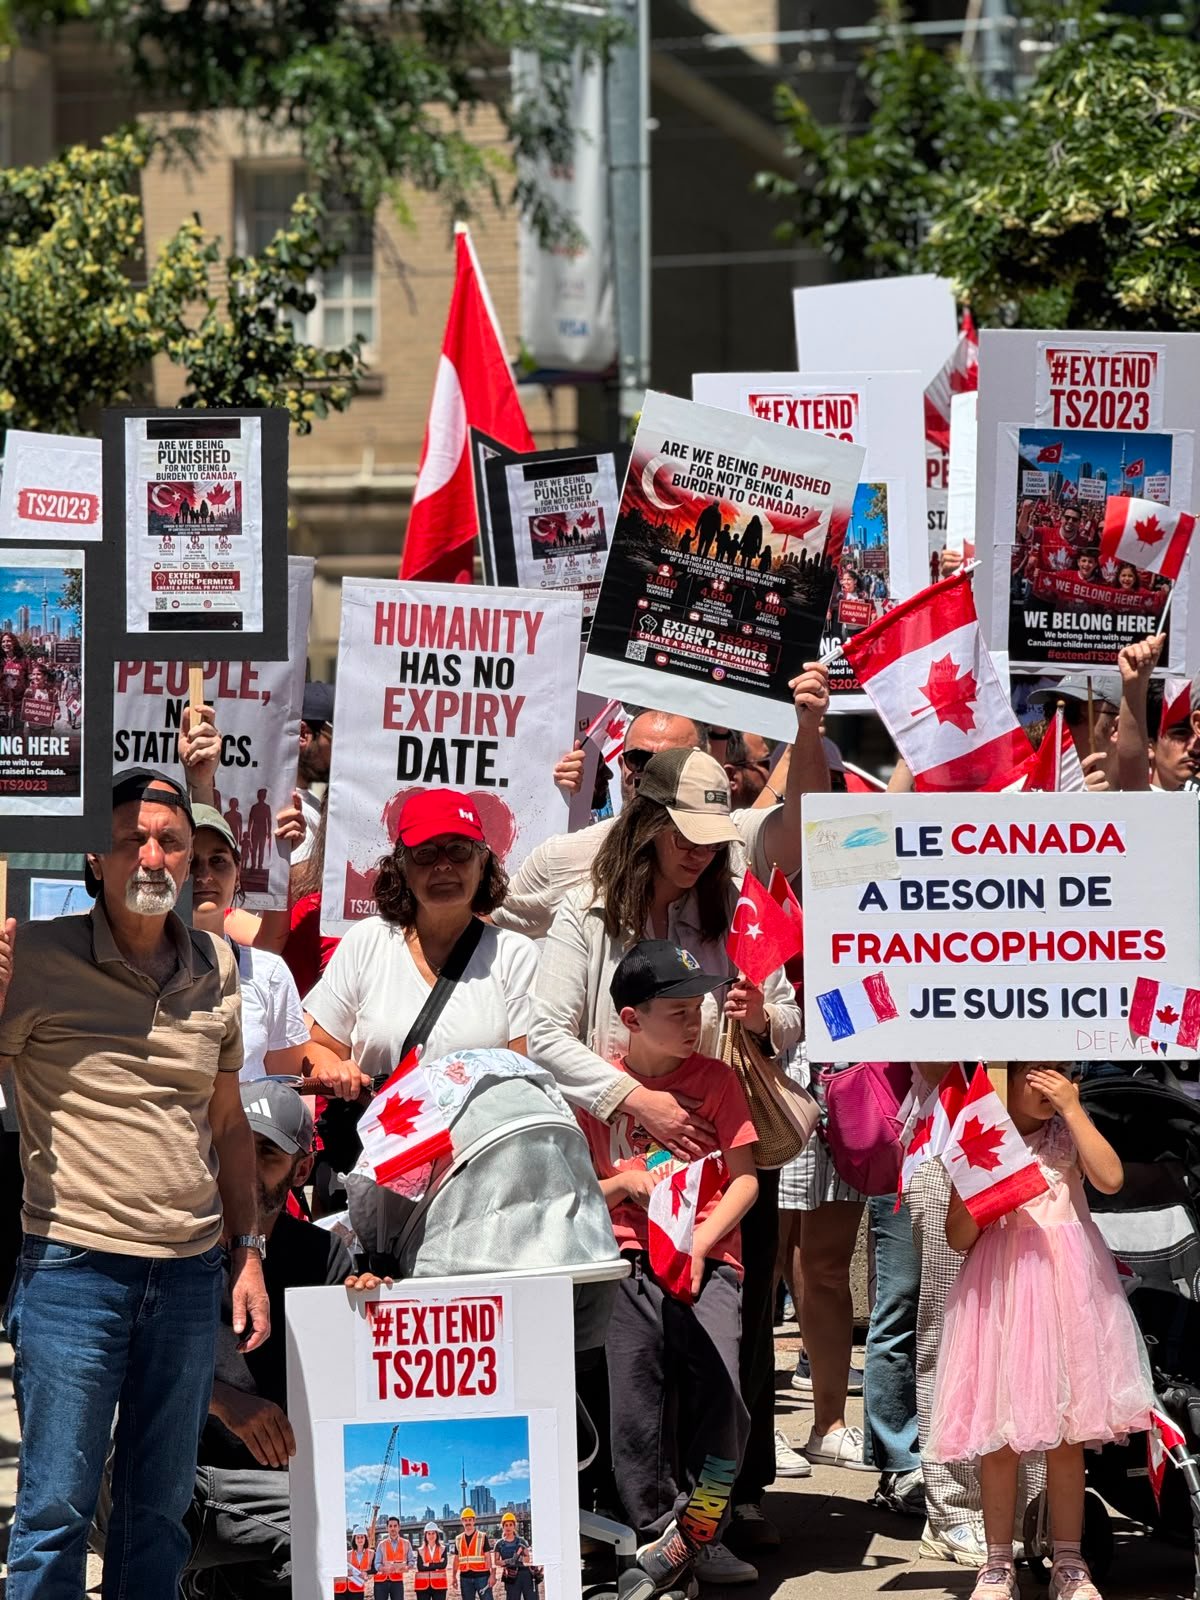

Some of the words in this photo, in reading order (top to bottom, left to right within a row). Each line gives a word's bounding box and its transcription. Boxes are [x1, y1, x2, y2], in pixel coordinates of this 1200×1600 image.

[1051, 356, 1150, 388] #EXTEND
[755, 400, 853, 429] #EXTEND
[1050, 390, 1150, 430] TS2023
[158, 441, 176, 449] ARE
[179, 441, 193, 449] WE
[196, 440, 223, 449] BEING
[158, 450, 231, 464] PUNISHED
[200, 472, 237, 480] CANADA?
[534, 480, 548, 488] ARE
[550, 479, 562, 487] WE
[564, 476, 586, 486] BEING
[660, 440, 689, 459] ARE
[690, 447, 714, 465] WE
[716, 454, 759, 477] BEING
[760, 465, 831, 496] PUNISHED
[688, 463, 714, 480] FOR
[716, 470, 742, 487] NOT
[744, 478, 783, 498] BEING
[784, 488, 795, 501] A
[27, 492, 91, 520] TS2023
[534, 483, 592, 500] PUNISHED
[534, 506, 559, 514] BURDEN
[570, 501, 599, 510] CANADA?
[671, 473, 725, 498] BURDEN
[727, 487, 745, 503] TO
[747, 492, 809, 519] CANADA?
[1055, 580, 1070, 592] WE
[1073, 584, 1111, 602] BELONG
[373, 601, 544, 655] HUMANITY
[662, 619, 715, 639] EXTEND
[718, 633, 768, 652] TS2023
[1024, 611, 1048, 629] WE
[1052, 612, 1112, 631] BELONG
[1117, 615, 1155, 633] HERE
[1057, 631, 1082, 640] belong
[639, 632, 670, 644] CREATE
[680, 642, 714, 655] SPECIAL
[717, 651, 728, 659] PR
[660, 627, 703, 645] WORK
[706, 639, 767, 661] PERMITS
[1048, 650, 1118, 661] #extendTS20
[1063, 640, 1092, 648] children
[1094, 641, 1116, 649] raised
[400, 651, 461, 687] HAS
[473, 656, 515, 690] NO
[382, 687, 526, 738] EXPIRY
[28, 737, 70, 755] HERE
[114, 730, 258, 767] STATICS.
[396, 735, 508, 788] DATE.
[895, 825, 943, 858] LE
[951, 823, 1126, 855] CANADA
[350, 899, 382, 914] TS20
[858, 881, 888, 912] A
[899, 878, 1045, 911] BESOIN
[1059, 875, 1112, 907] DE
[831, 929, 1166, 964] FRANCOPHONES
[910, 987, 956, 1018] JE
[963, 986, 1049, 1019] SUIS
[1061, 986, 1107, 1018] ICI
[1076, 1029, 1152, 1054] DEFNE
[372, 1304, 495, 1347] #EXTEND
[373, 1346, 497, 1400] TS2023
